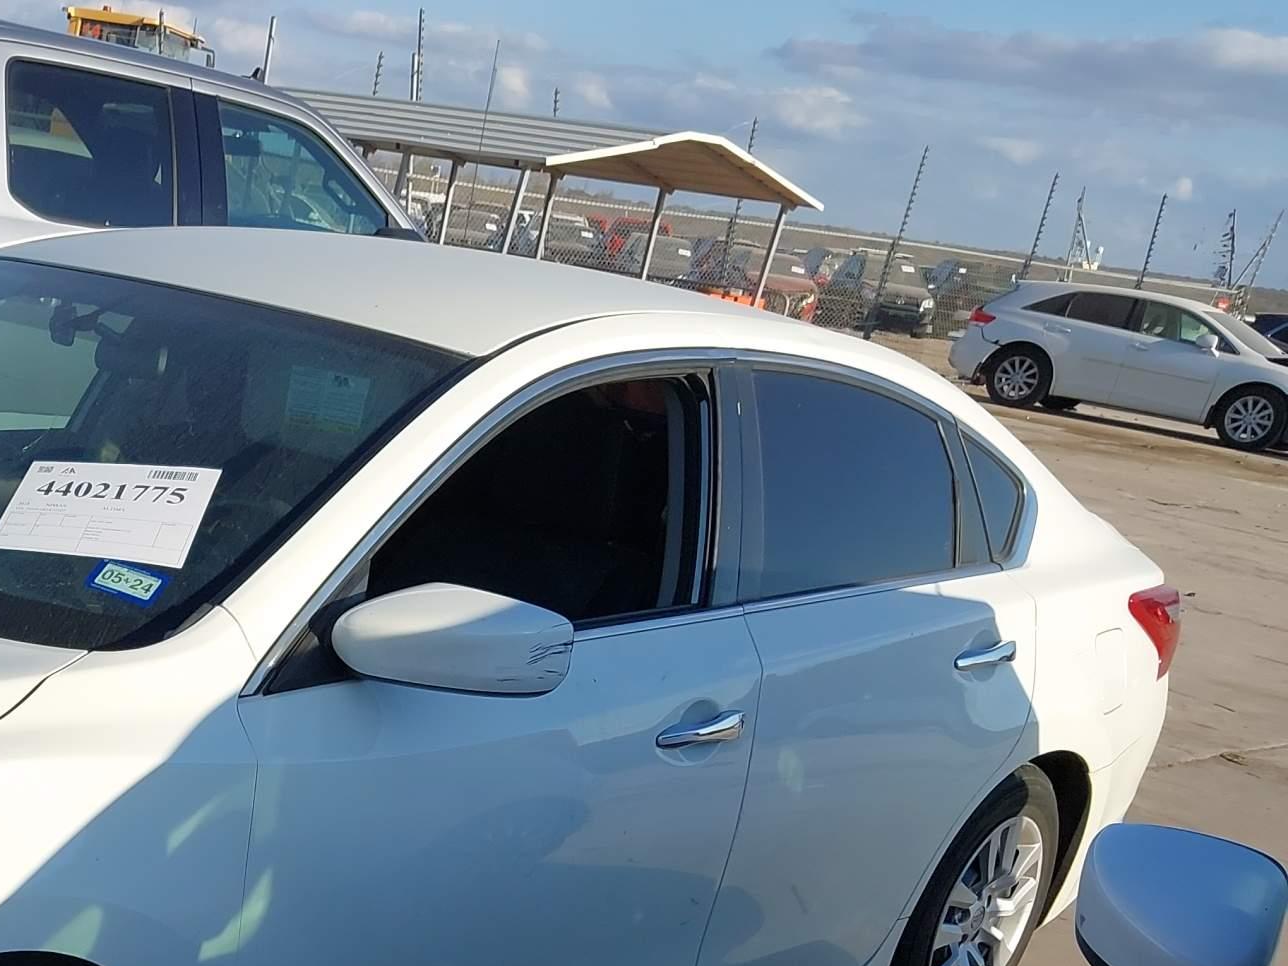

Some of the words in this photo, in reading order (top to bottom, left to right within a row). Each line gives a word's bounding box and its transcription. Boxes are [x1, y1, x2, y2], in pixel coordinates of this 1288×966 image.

[36, 480, 189, 505] 44021775
[101, 569, 125, 584] 05
[128, 578, 154, 594] 24
